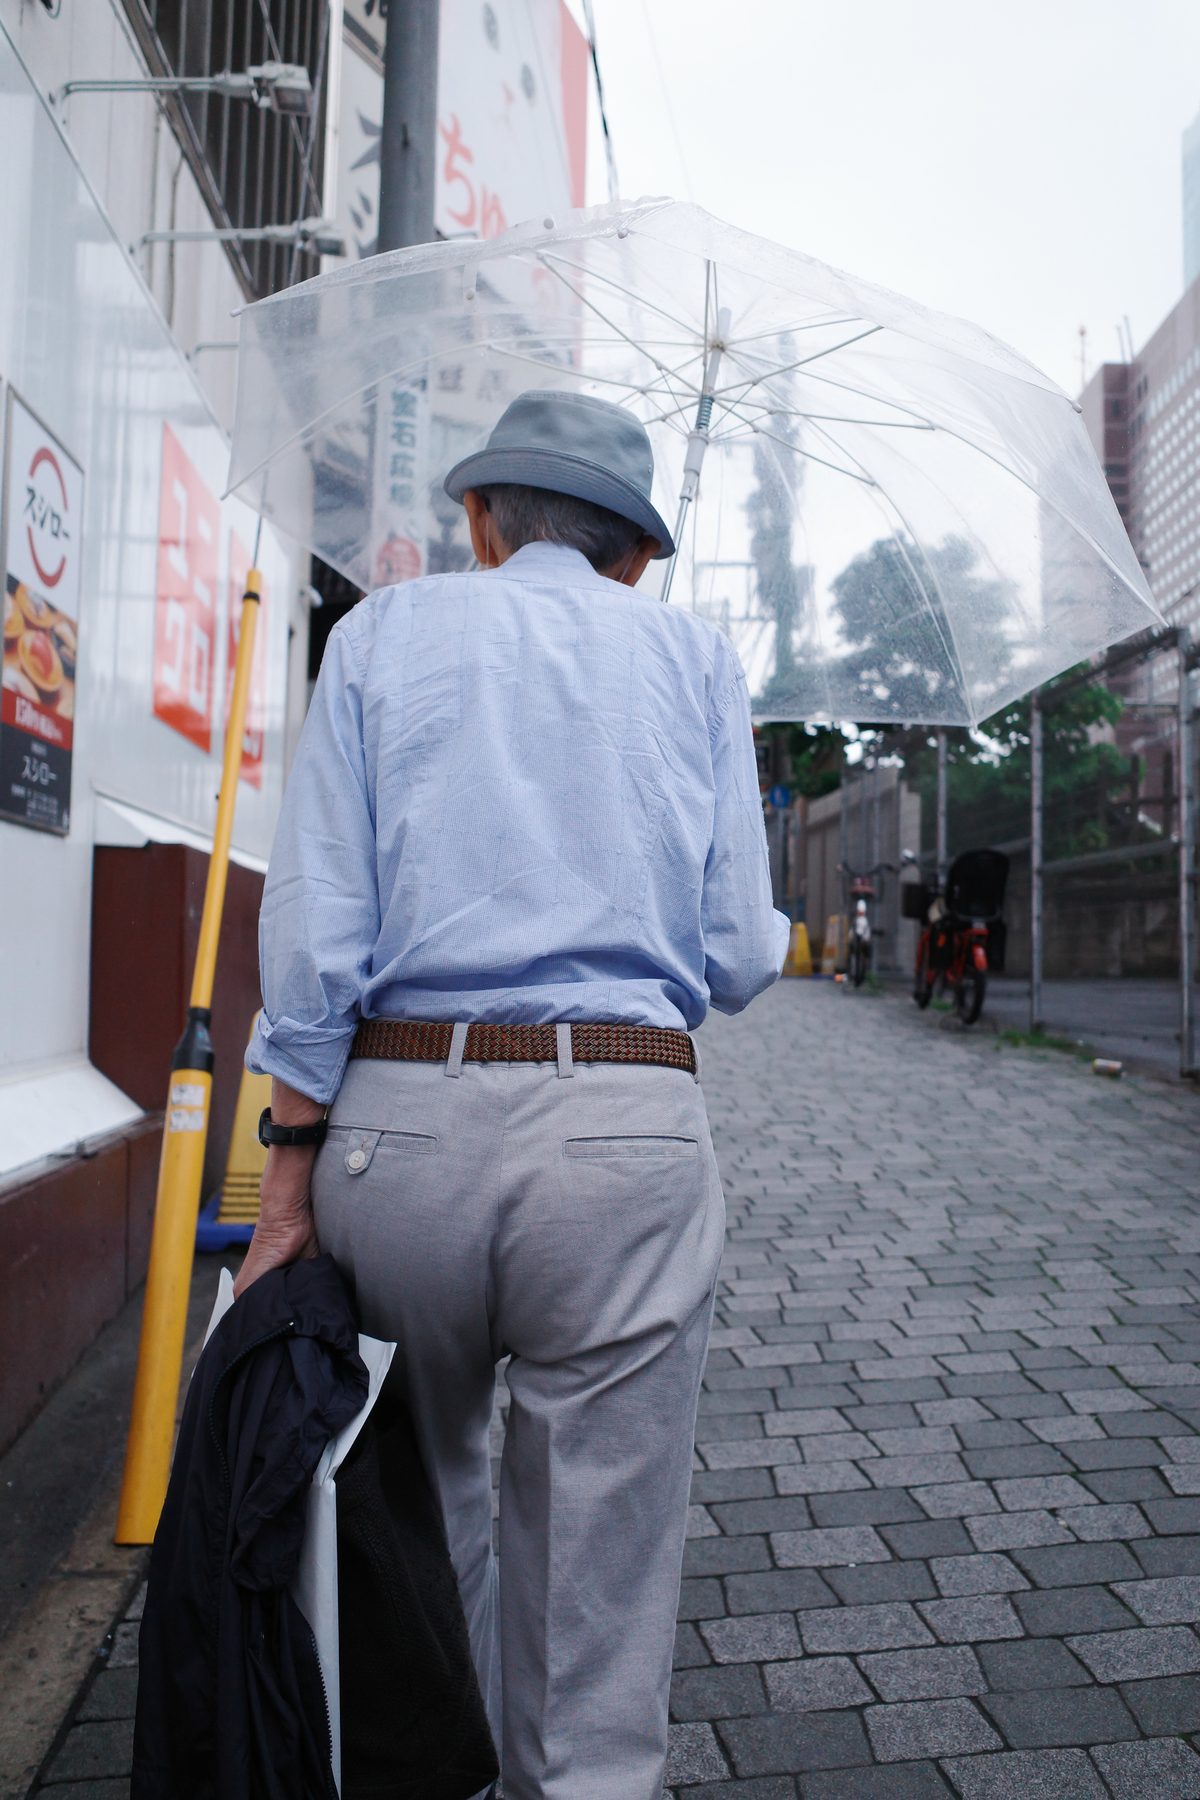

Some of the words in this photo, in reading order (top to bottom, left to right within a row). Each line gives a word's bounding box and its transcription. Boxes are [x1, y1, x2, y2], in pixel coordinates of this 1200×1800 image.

[25, 484, 70, 541] スシロー
[21, 755, 58, 786] スシロー
